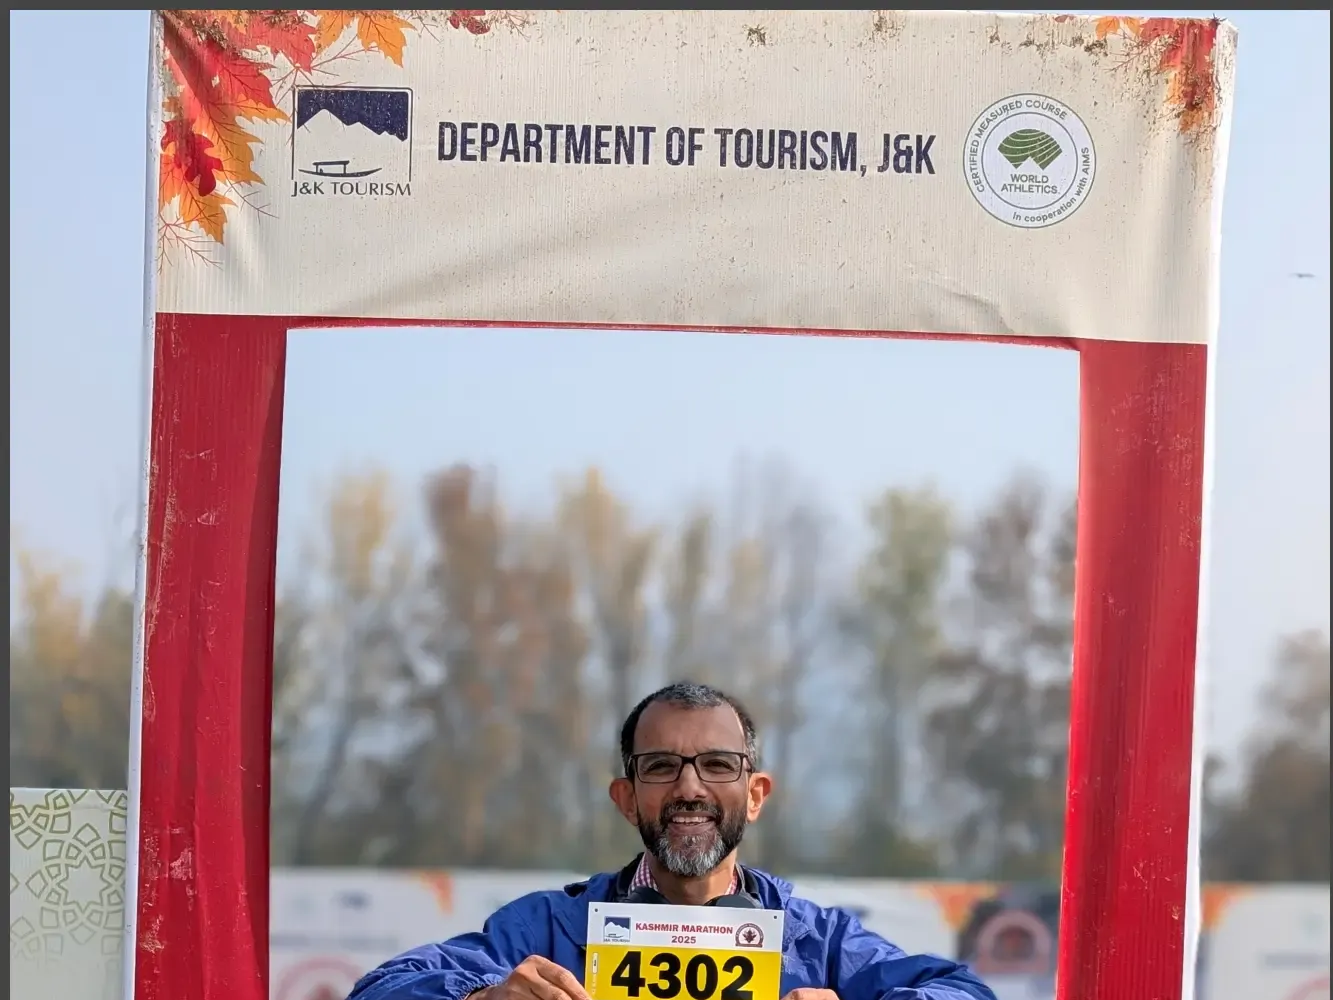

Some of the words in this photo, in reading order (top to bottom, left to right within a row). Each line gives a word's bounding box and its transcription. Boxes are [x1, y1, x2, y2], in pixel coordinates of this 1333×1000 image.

[975, 100, 1023, 139] MEASURED
[1025, 99, 1068, 120] COURSE
[437, 121, 656, 166] DEPARTMENT
[665, 126, 705, 167] OF
[714, 128, 866, 177] TOURISM,
[877, 133, 937, 175] J&K
[969, 139, 985, 193] CERTIFIED
[1081, 147, 1090, 175] AIMS
[1010, 173, 1049, 184] WORLD
[1075, 177, 1088, 197] with
[291, 181, 324, 197] J&K
[331, 181, 412, 196] TOURISM
[1000, 184, 1058, 194] ATHLETICS
[1012, 212, 1022, 221] In
[1024, 196, 1077, 223] cooperation
[635, 922, 679, 932] KASHMIR
[681, 924, 733, 934] MARATHON
[671, 935, 697, 944] 2025
